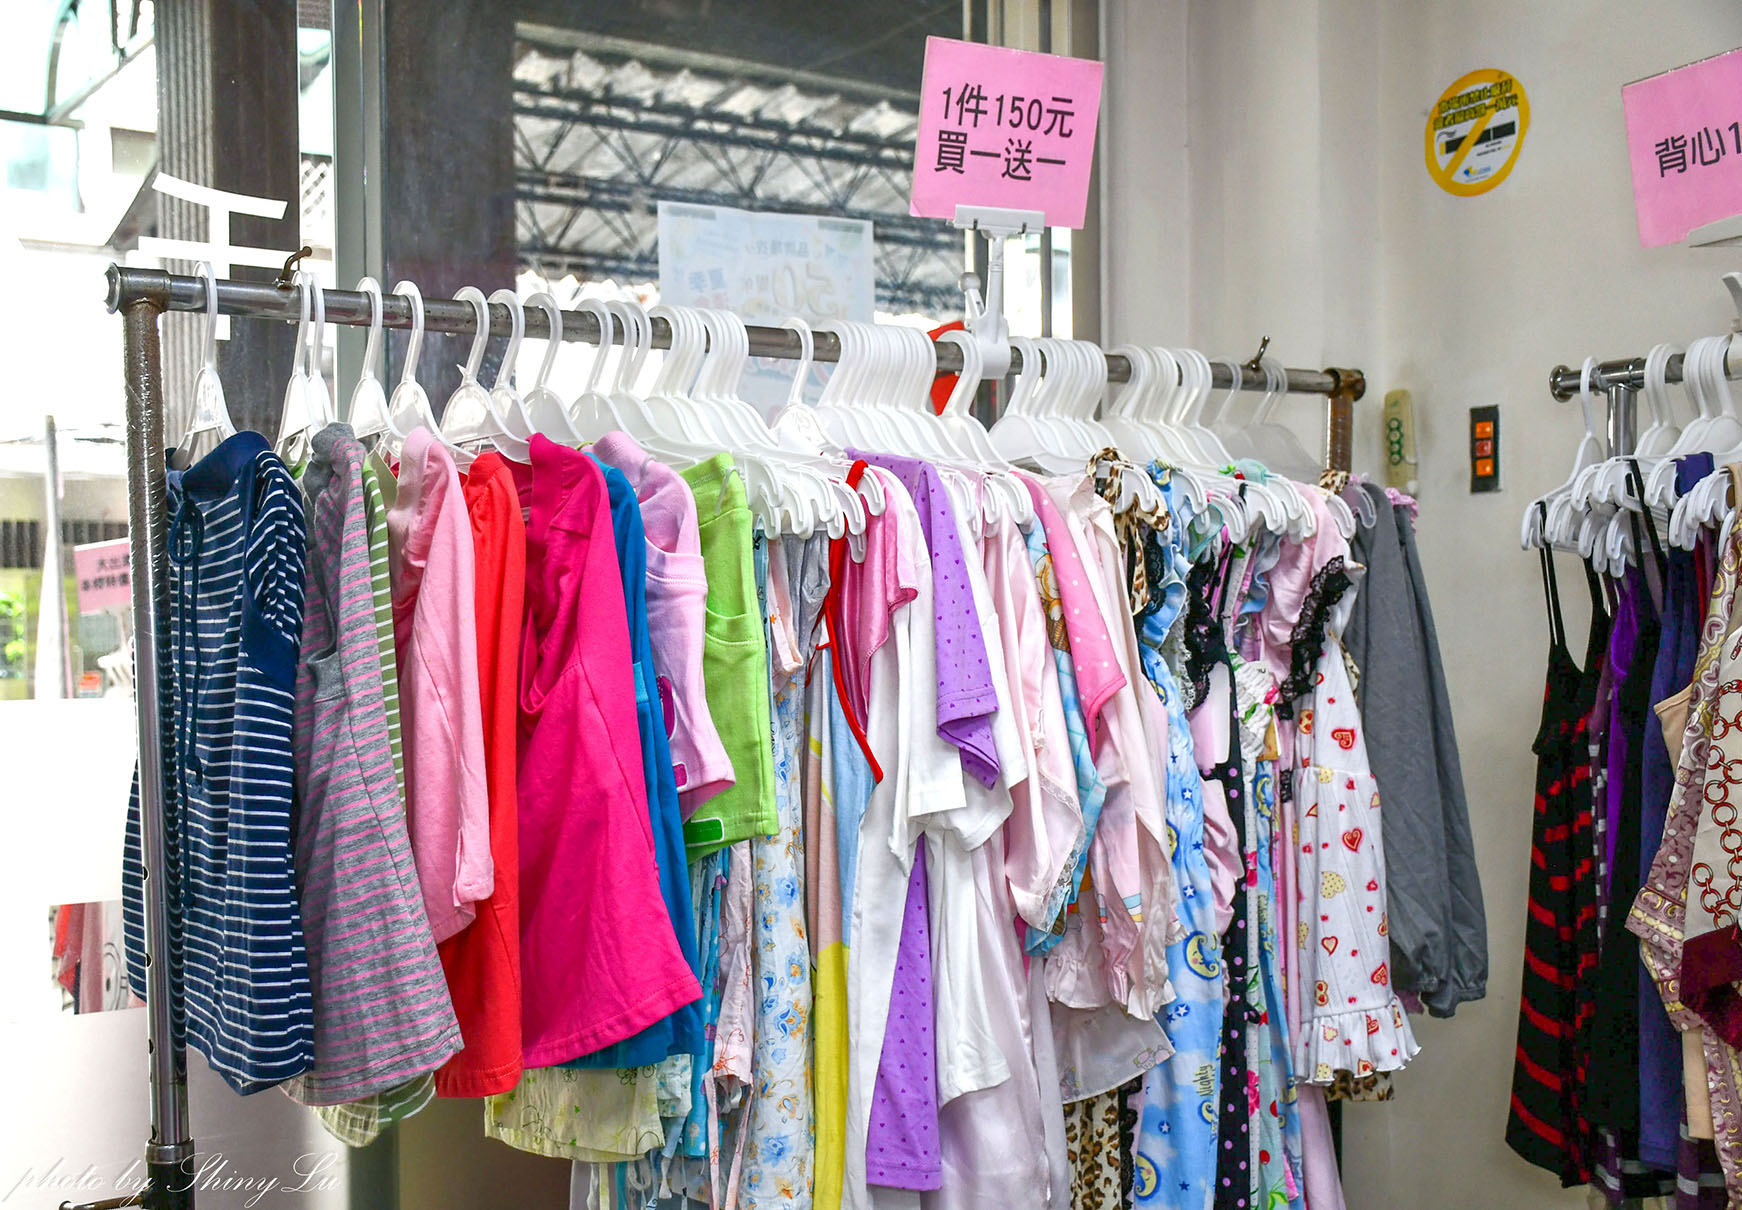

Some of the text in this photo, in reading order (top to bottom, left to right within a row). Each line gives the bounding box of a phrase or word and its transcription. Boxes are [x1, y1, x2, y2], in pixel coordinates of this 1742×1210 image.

[942, 83, 1075, 138] 1件150元
[934, 130, 1067, 181] 買一送一
